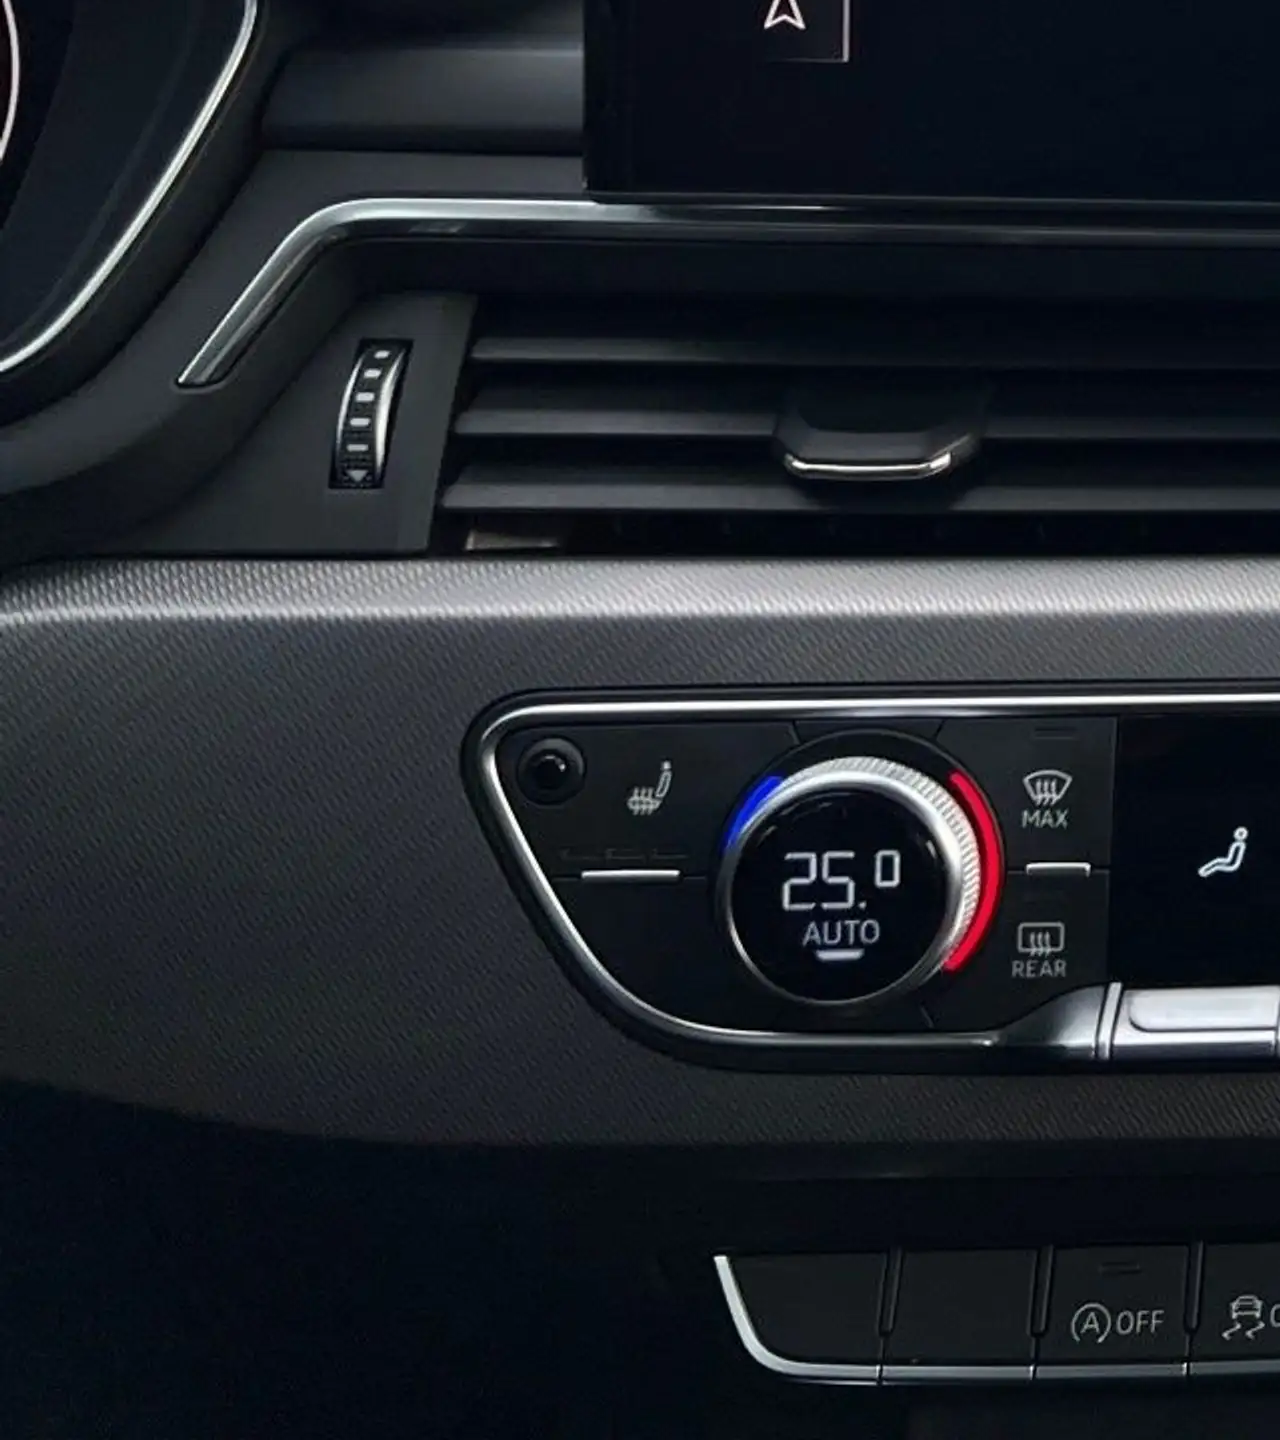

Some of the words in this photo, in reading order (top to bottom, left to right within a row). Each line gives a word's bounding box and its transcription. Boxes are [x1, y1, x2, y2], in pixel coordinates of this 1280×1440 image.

[1022, 809, 1068, 828] MAX
[802, 919, 880, 945] AUTO
[1011, 960, 1067, 978] REAR
[1116, 1310, 1165, 1335] OFF
